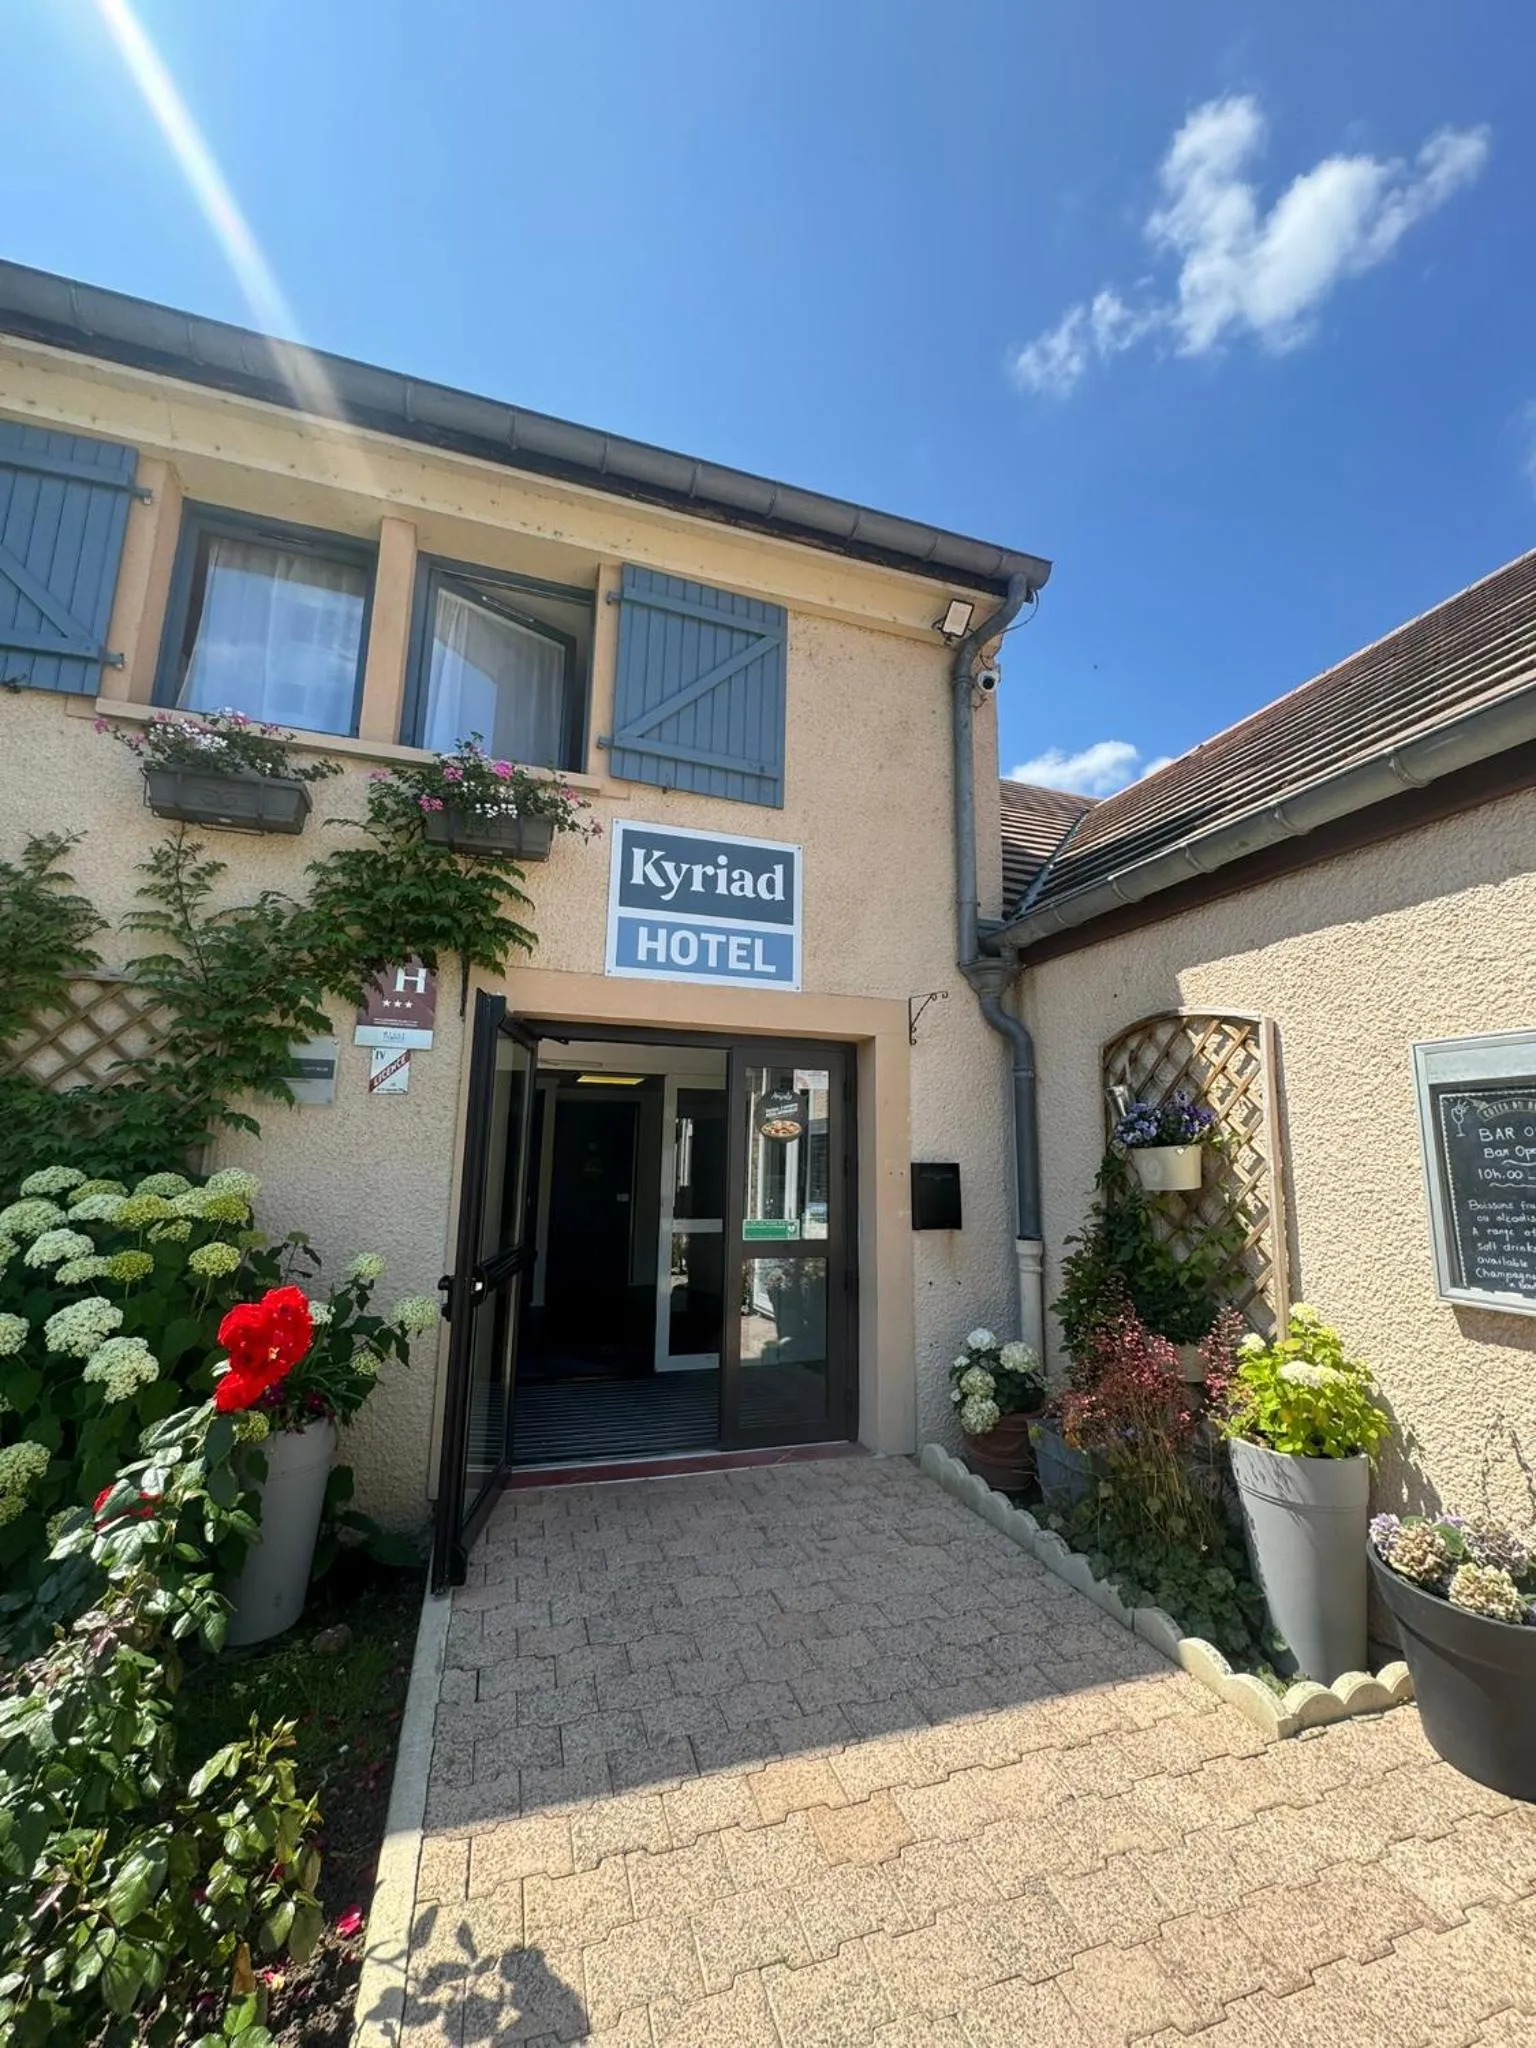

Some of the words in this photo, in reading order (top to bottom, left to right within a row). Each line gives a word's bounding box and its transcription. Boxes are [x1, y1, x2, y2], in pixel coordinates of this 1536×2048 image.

[630, 847, 786, 901] Kyriad
[636, 926, 777, 973] HOTEL
[393, 967, 428, 994] H
[375, 1050, 386, 1060] IV
[373, 1055, 406, 1086] LICENCE
[1478, 1127, 1516, 1142] BAR
[1472, 1226, 1479, 1236] A
[1487, 1228, 1515, 1242] range
[1477, 1256, 1528, 1268] available
